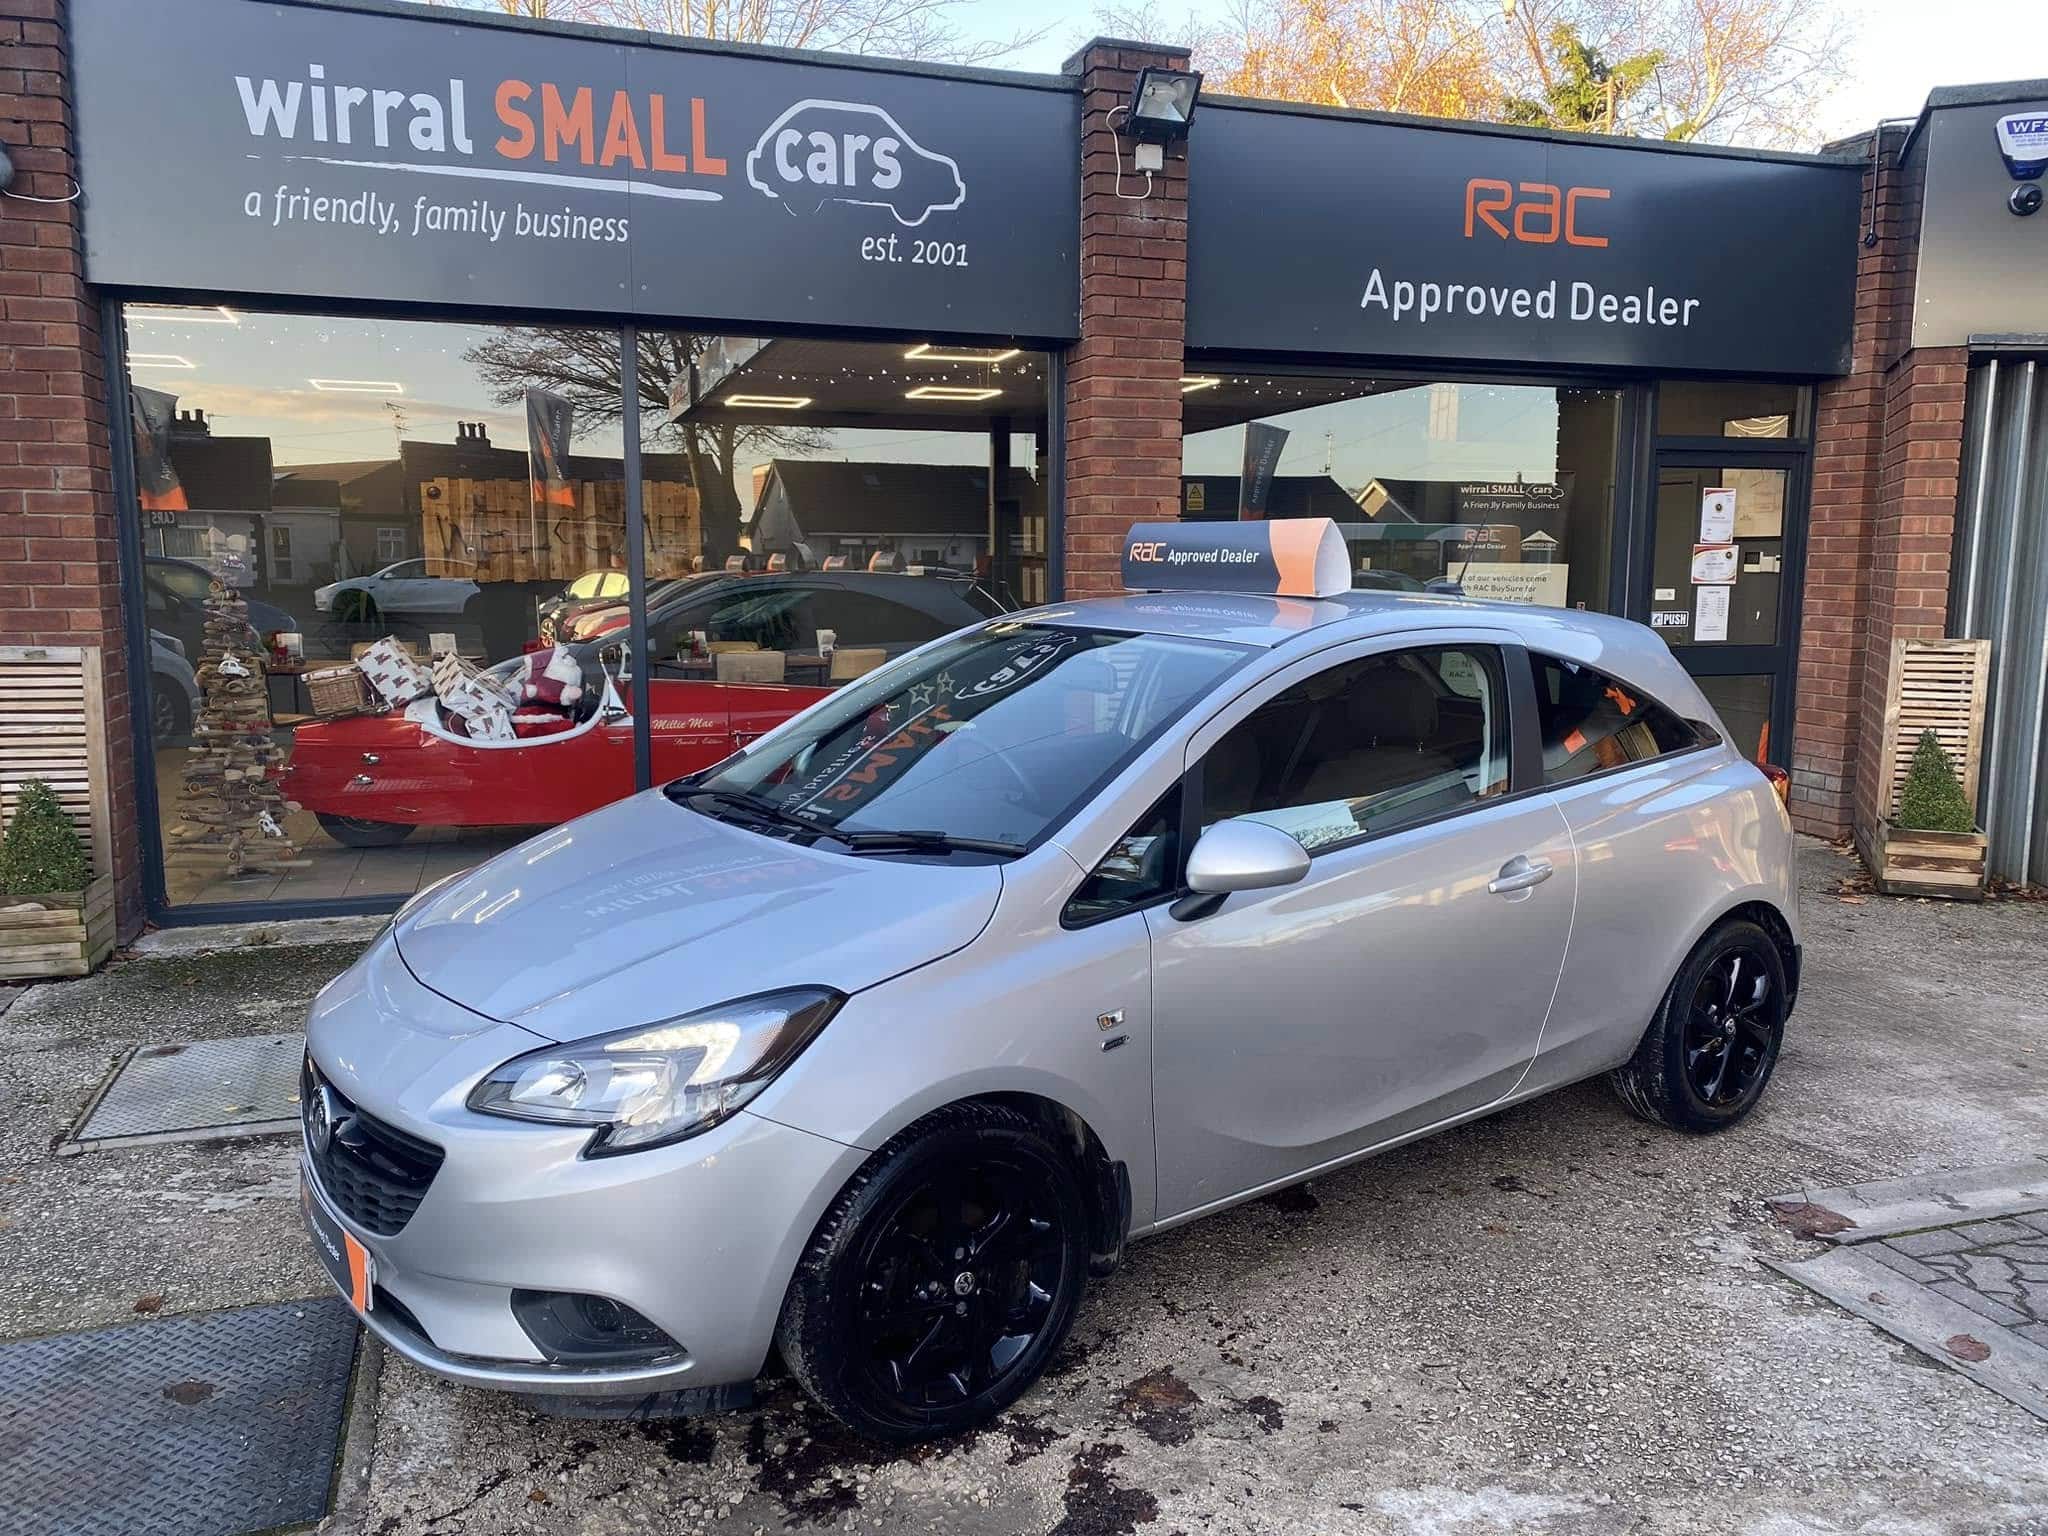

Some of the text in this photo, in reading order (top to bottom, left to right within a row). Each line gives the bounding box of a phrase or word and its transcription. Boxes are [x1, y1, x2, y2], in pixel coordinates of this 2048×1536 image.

[236, 64, 902, 189] wirral SMALL cars
[244, 186, 630, 243] a friendly, family business
[860, 234, 969, 267] est. 2001
[1360, 268, 1700, 327] Approved Dealer
[1460, 484, 1489, 494] wirral
[1491, 485, 1525, 494] SMALL
[1502, 501, 1526, 511] Family
[1528, 501, 1560, 509] Business
[1168, 548, 1218, 566] Approved
[1220, 548, 1259, 563] Dealer
[1473, 584, 1488, 592] RAC
[1491, 584, 1524, 593] BuySure
[1663, 613, 1687, 625] PUSH
[652, 719, 685, 730] Millie
